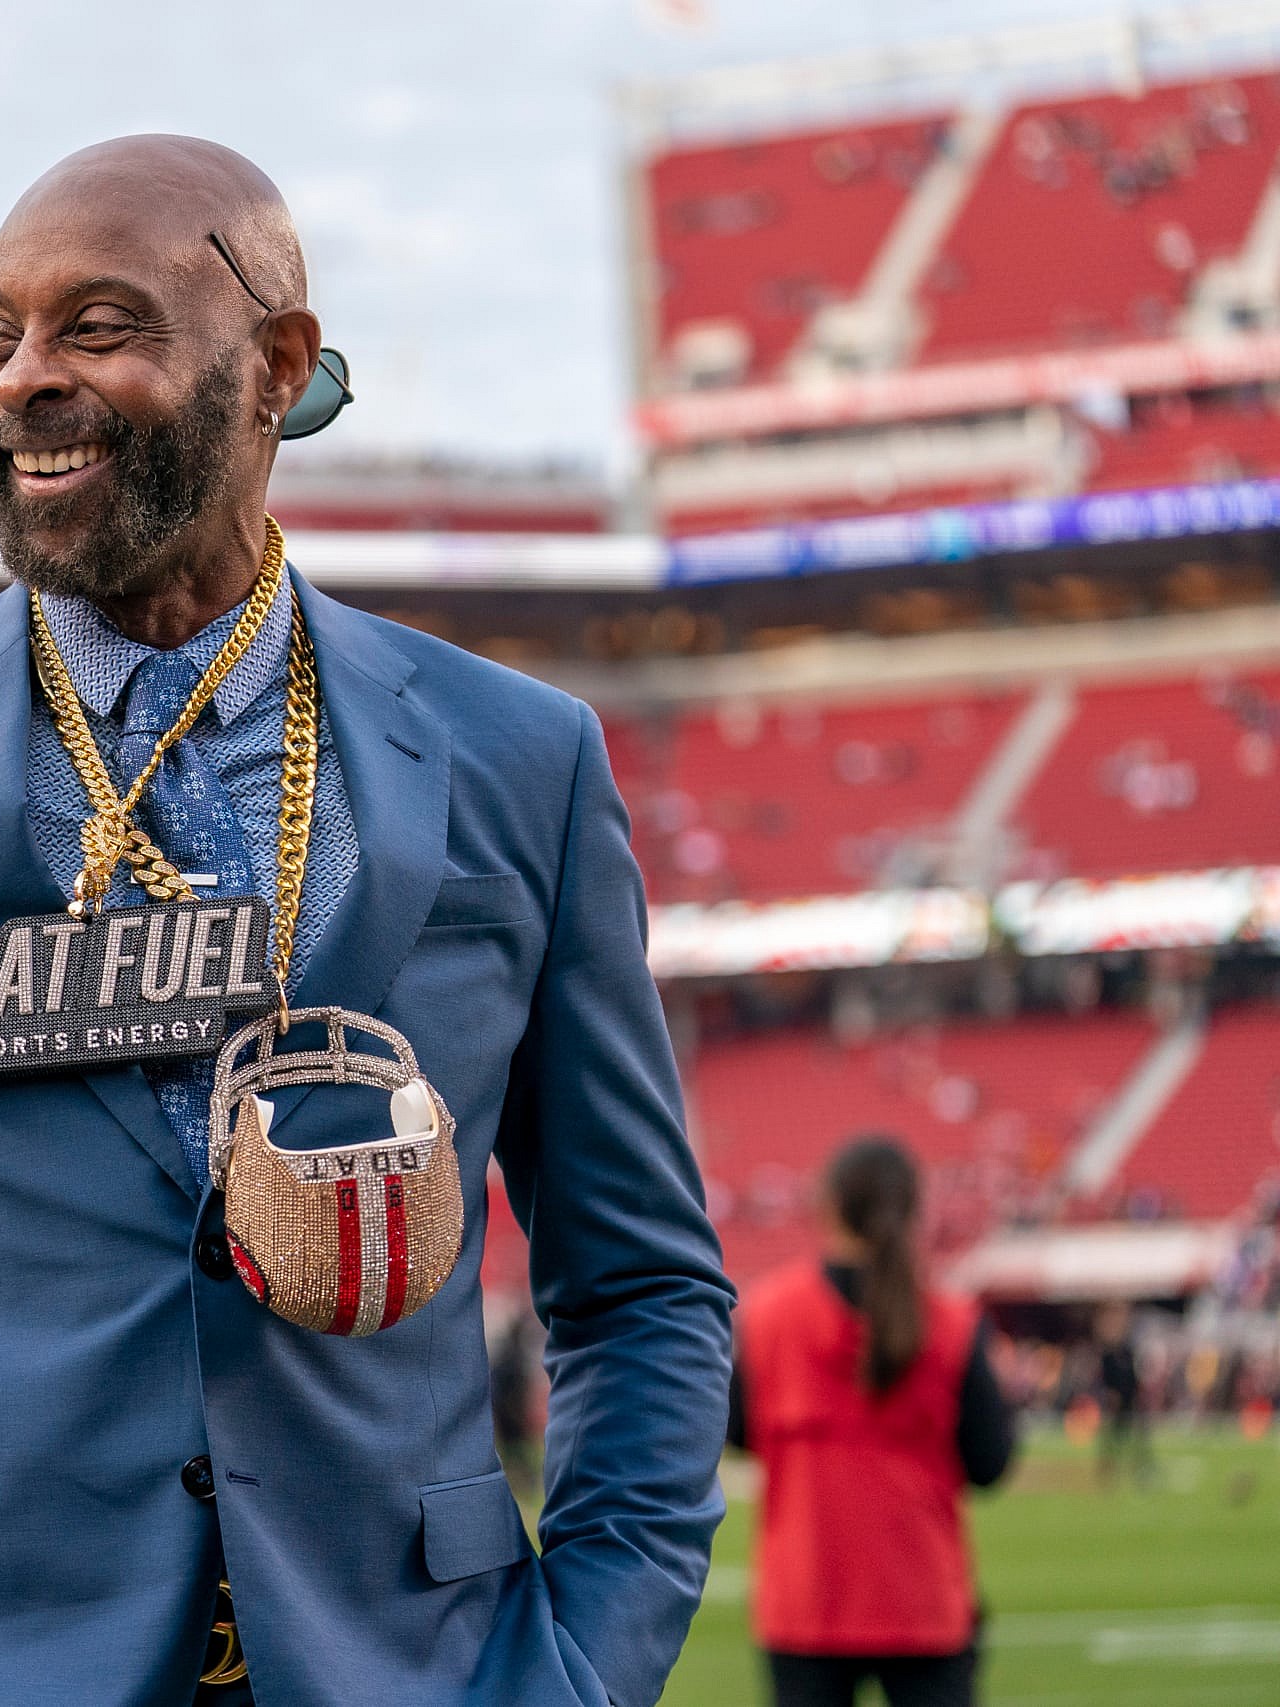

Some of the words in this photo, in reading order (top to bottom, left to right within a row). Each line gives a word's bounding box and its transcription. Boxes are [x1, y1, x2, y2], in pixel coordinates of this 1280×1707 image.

[98, 905, 263, 1008] FUEL
[86, 1017, 212, 1050] ENERGY
[302, 1146, 419, 1181] GOAT
